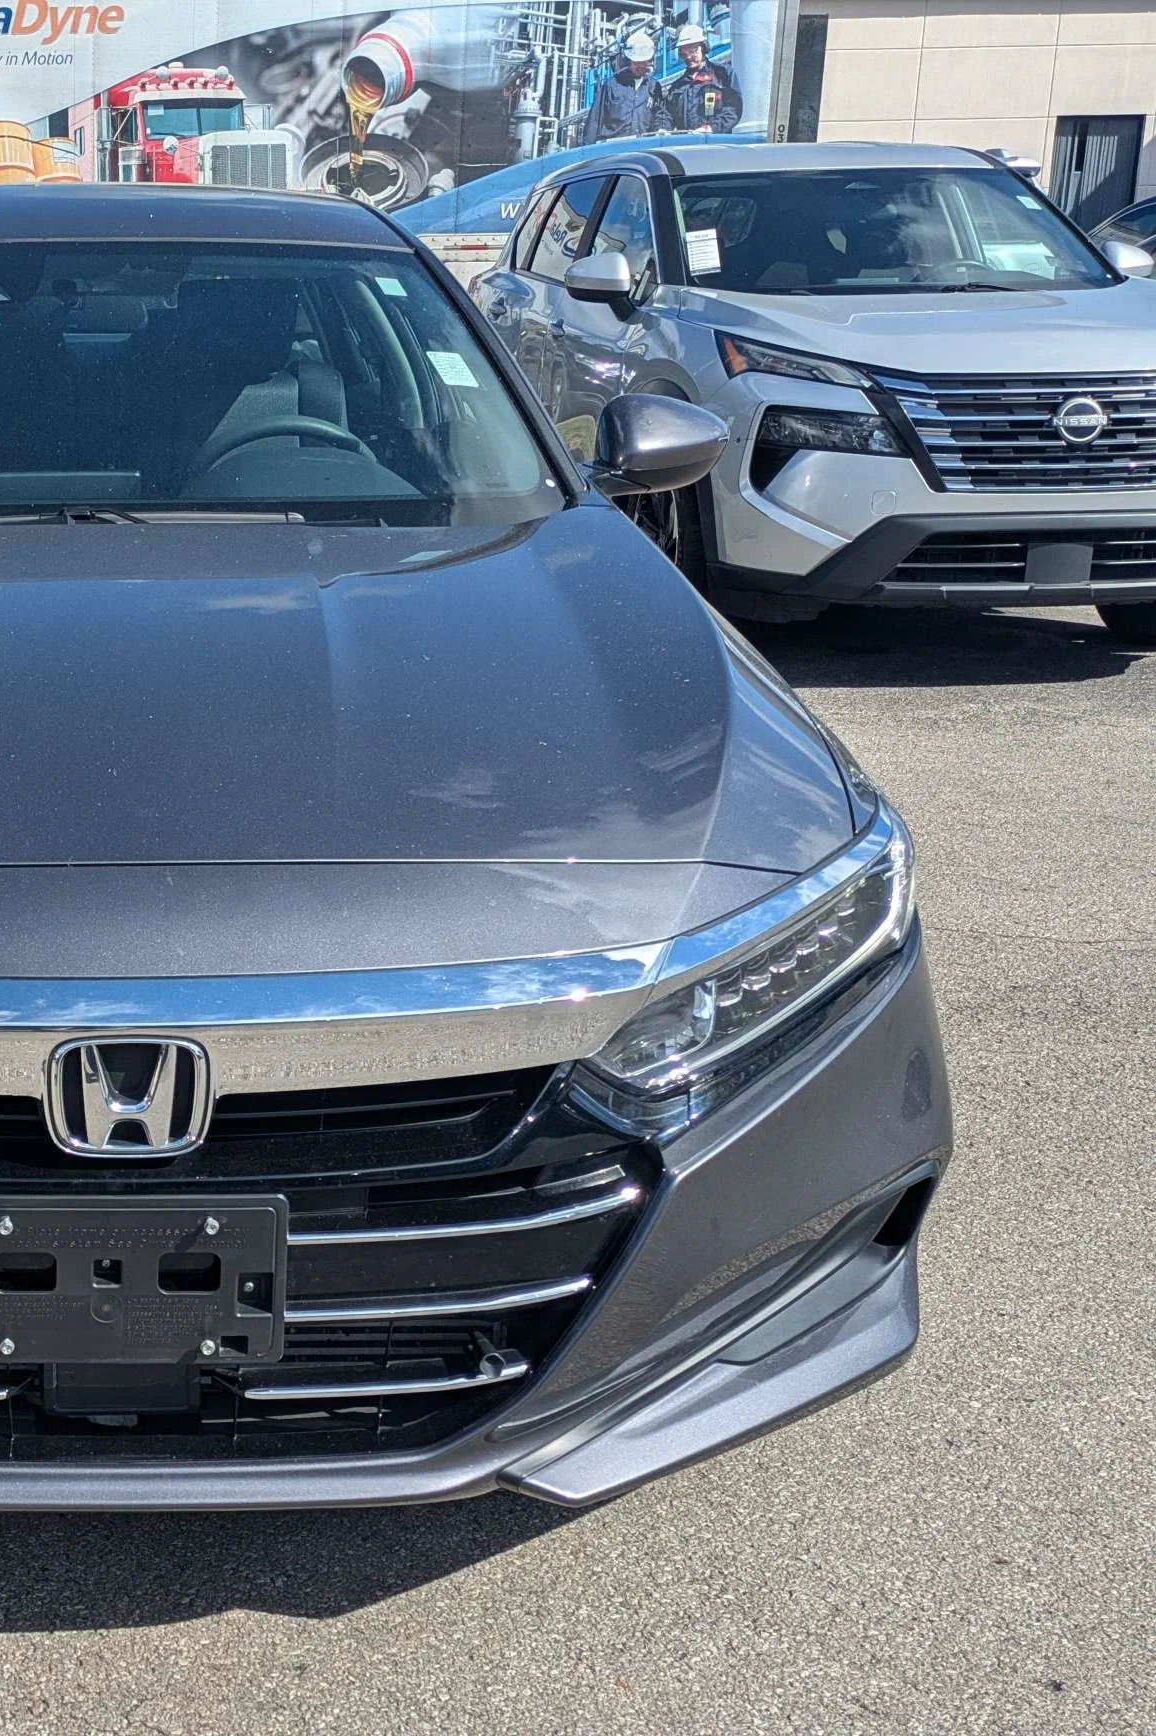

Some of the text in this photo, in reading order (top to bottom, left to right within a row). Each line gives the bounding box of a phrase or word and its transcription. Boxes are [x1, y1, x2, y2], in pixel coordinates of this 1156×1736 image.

[5, 52, 18, 66] in
[21, 51, 73, 66] Motion
[1053, 417, 1107, 426] NISSAN
